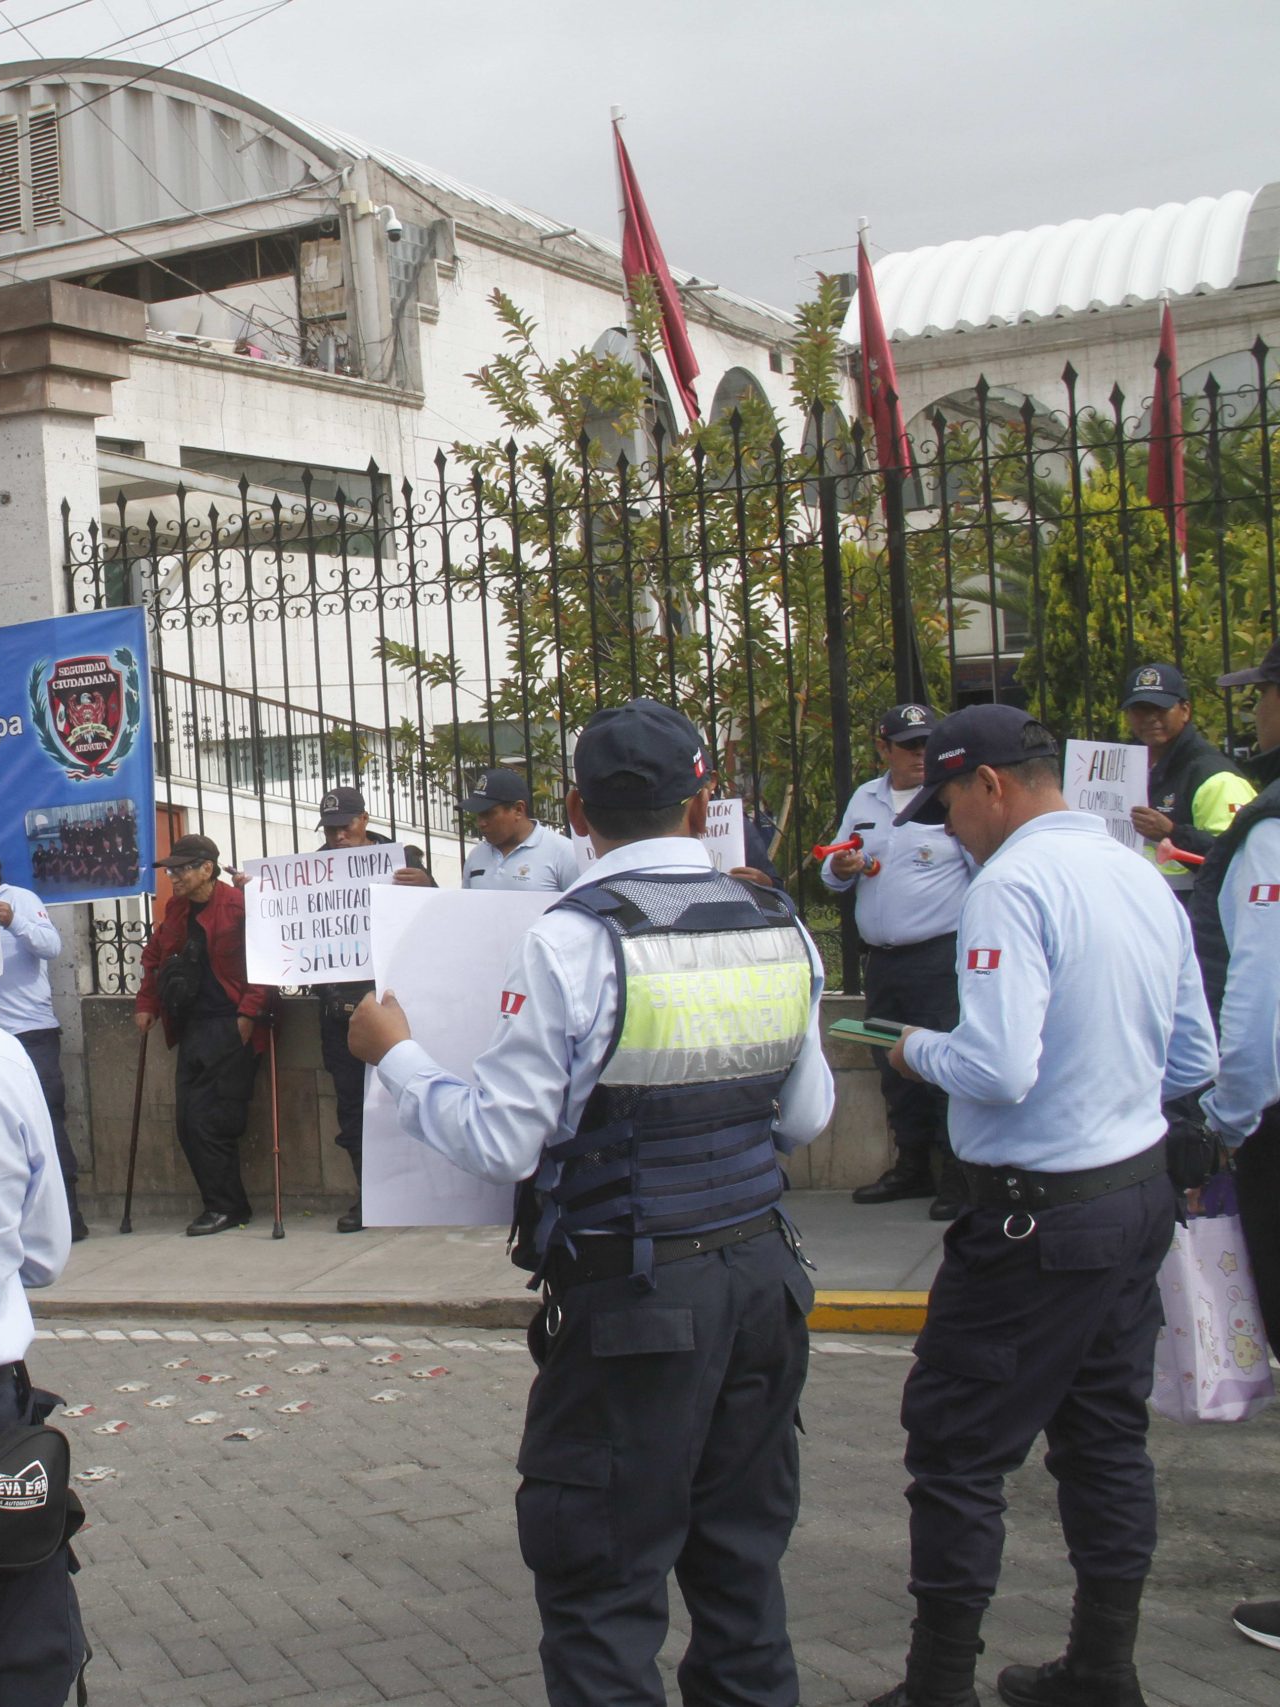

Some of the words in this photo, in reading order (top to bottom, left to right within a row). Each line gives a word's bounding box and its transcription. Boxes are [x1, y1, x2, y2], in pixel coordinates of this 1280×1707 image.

[52, 672, 115, 690] CIUDADANA
[58, 661, 106, 677] SEGURIDAD
[259, 857, 335, 892] ALCALDE
[347, 852, 393, 878] CUMPLA
[260, 896, 284, 919] CON
[286, 895, 298, 916] LA
[307, 887, 371, 913] BONIFICACI
[281, 922, 305, 942] DEL
[312, 913, 359, 939] RIESGO
[299, 941, 369, 973] SALUD
[649, 966, 802, 1009] SERENAZGO
[671, 1007, 783, 1045] AREQUIPA
[25, 1479, 48, 1496] ERA
